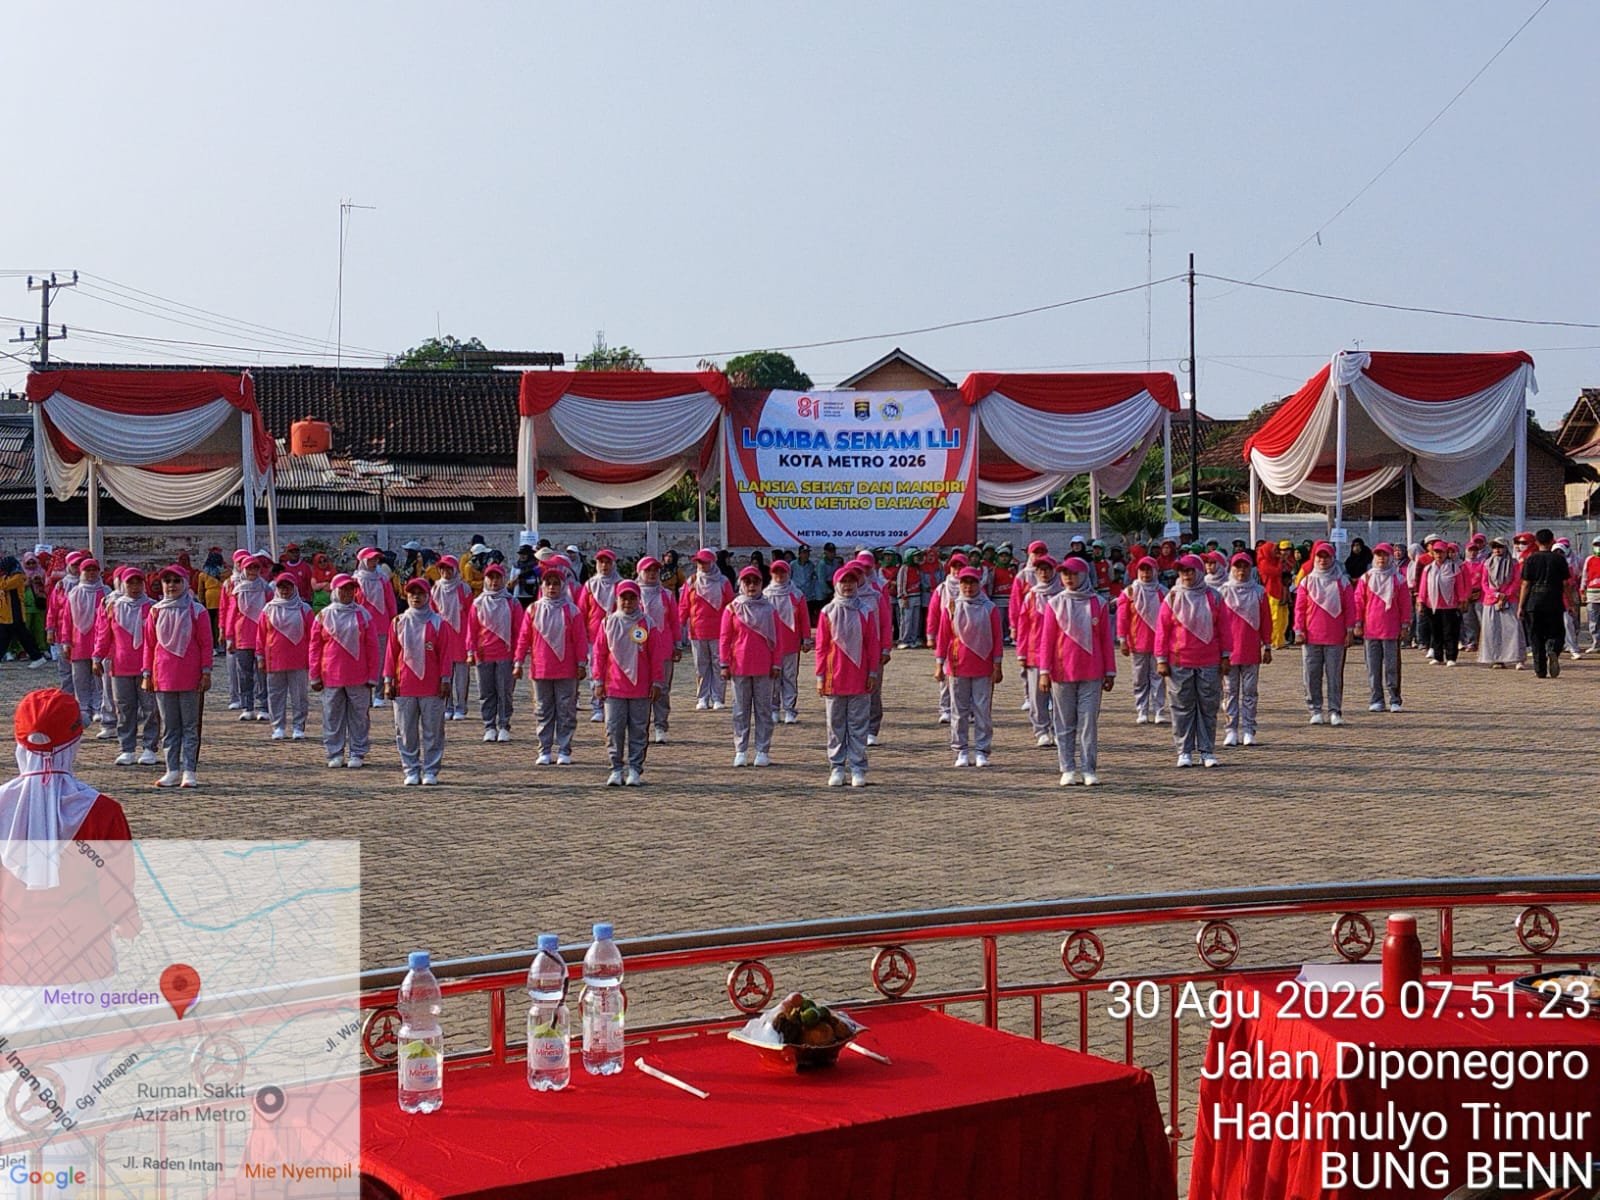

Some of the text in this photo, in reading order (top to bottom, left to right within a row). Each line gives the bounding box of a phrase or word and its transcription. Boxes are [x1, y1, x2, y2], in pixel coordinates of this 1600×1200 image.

[797, 397, 819, 420] 81
[743, 428, 960, 449] LOMBA SENAM LLI
[779, 454, 926, 468] KOTA METRO 2026
[738, 480, 966, 493] LANSIA SEHAT DAN MANDIRI
[756, 497, 949, 509] UNTUK METRO BAHAGIA
[798, 530, 831, 538] METRO,
